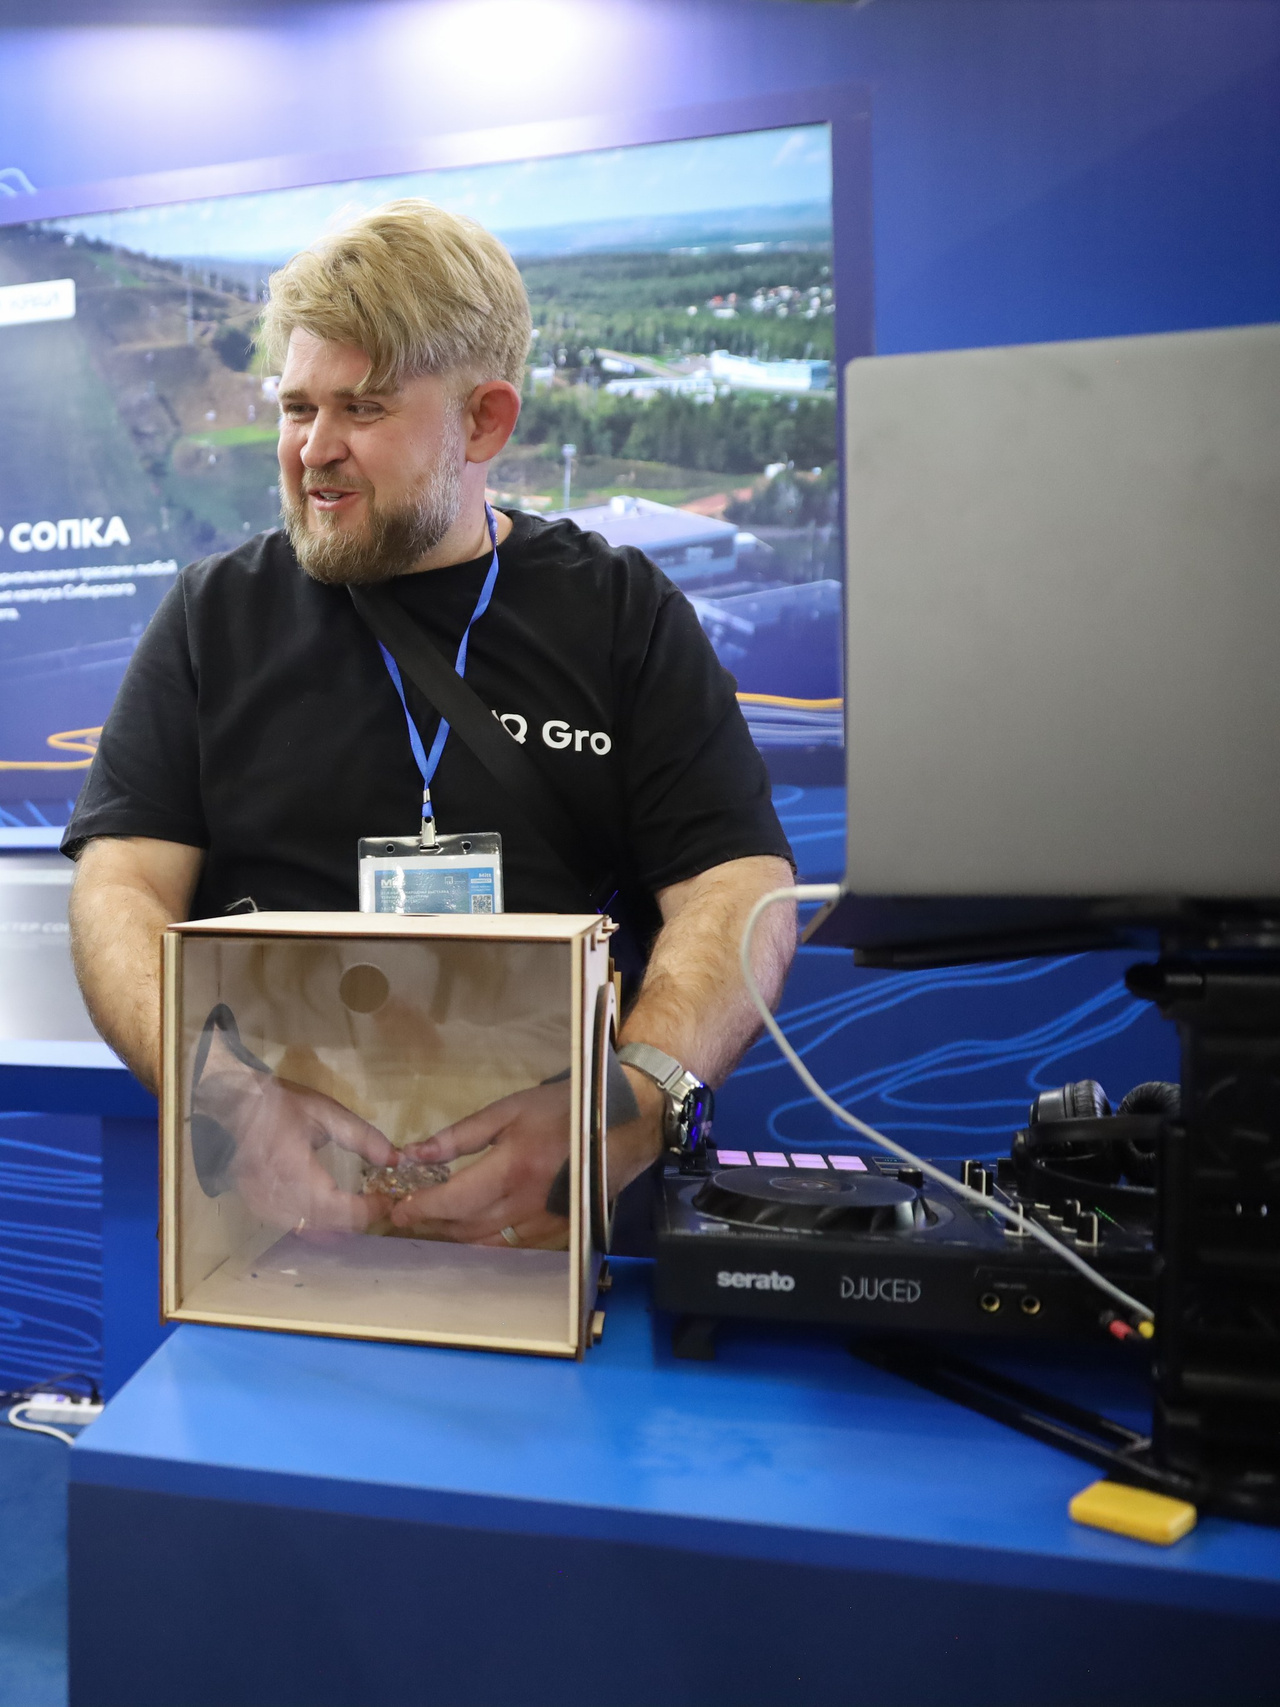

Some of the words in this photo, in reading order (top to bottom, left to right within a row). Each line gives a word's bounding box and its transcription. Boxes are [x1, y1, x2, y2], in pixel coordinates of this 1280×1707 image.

[9, 515, 131, 554] СОПКА
[491, 709, 528, 745] Q
[542, 719, 612, 756] Gro
[717, 1270, 796, 1292] serato
[840, 1275, 921, 1303] DJUCED
